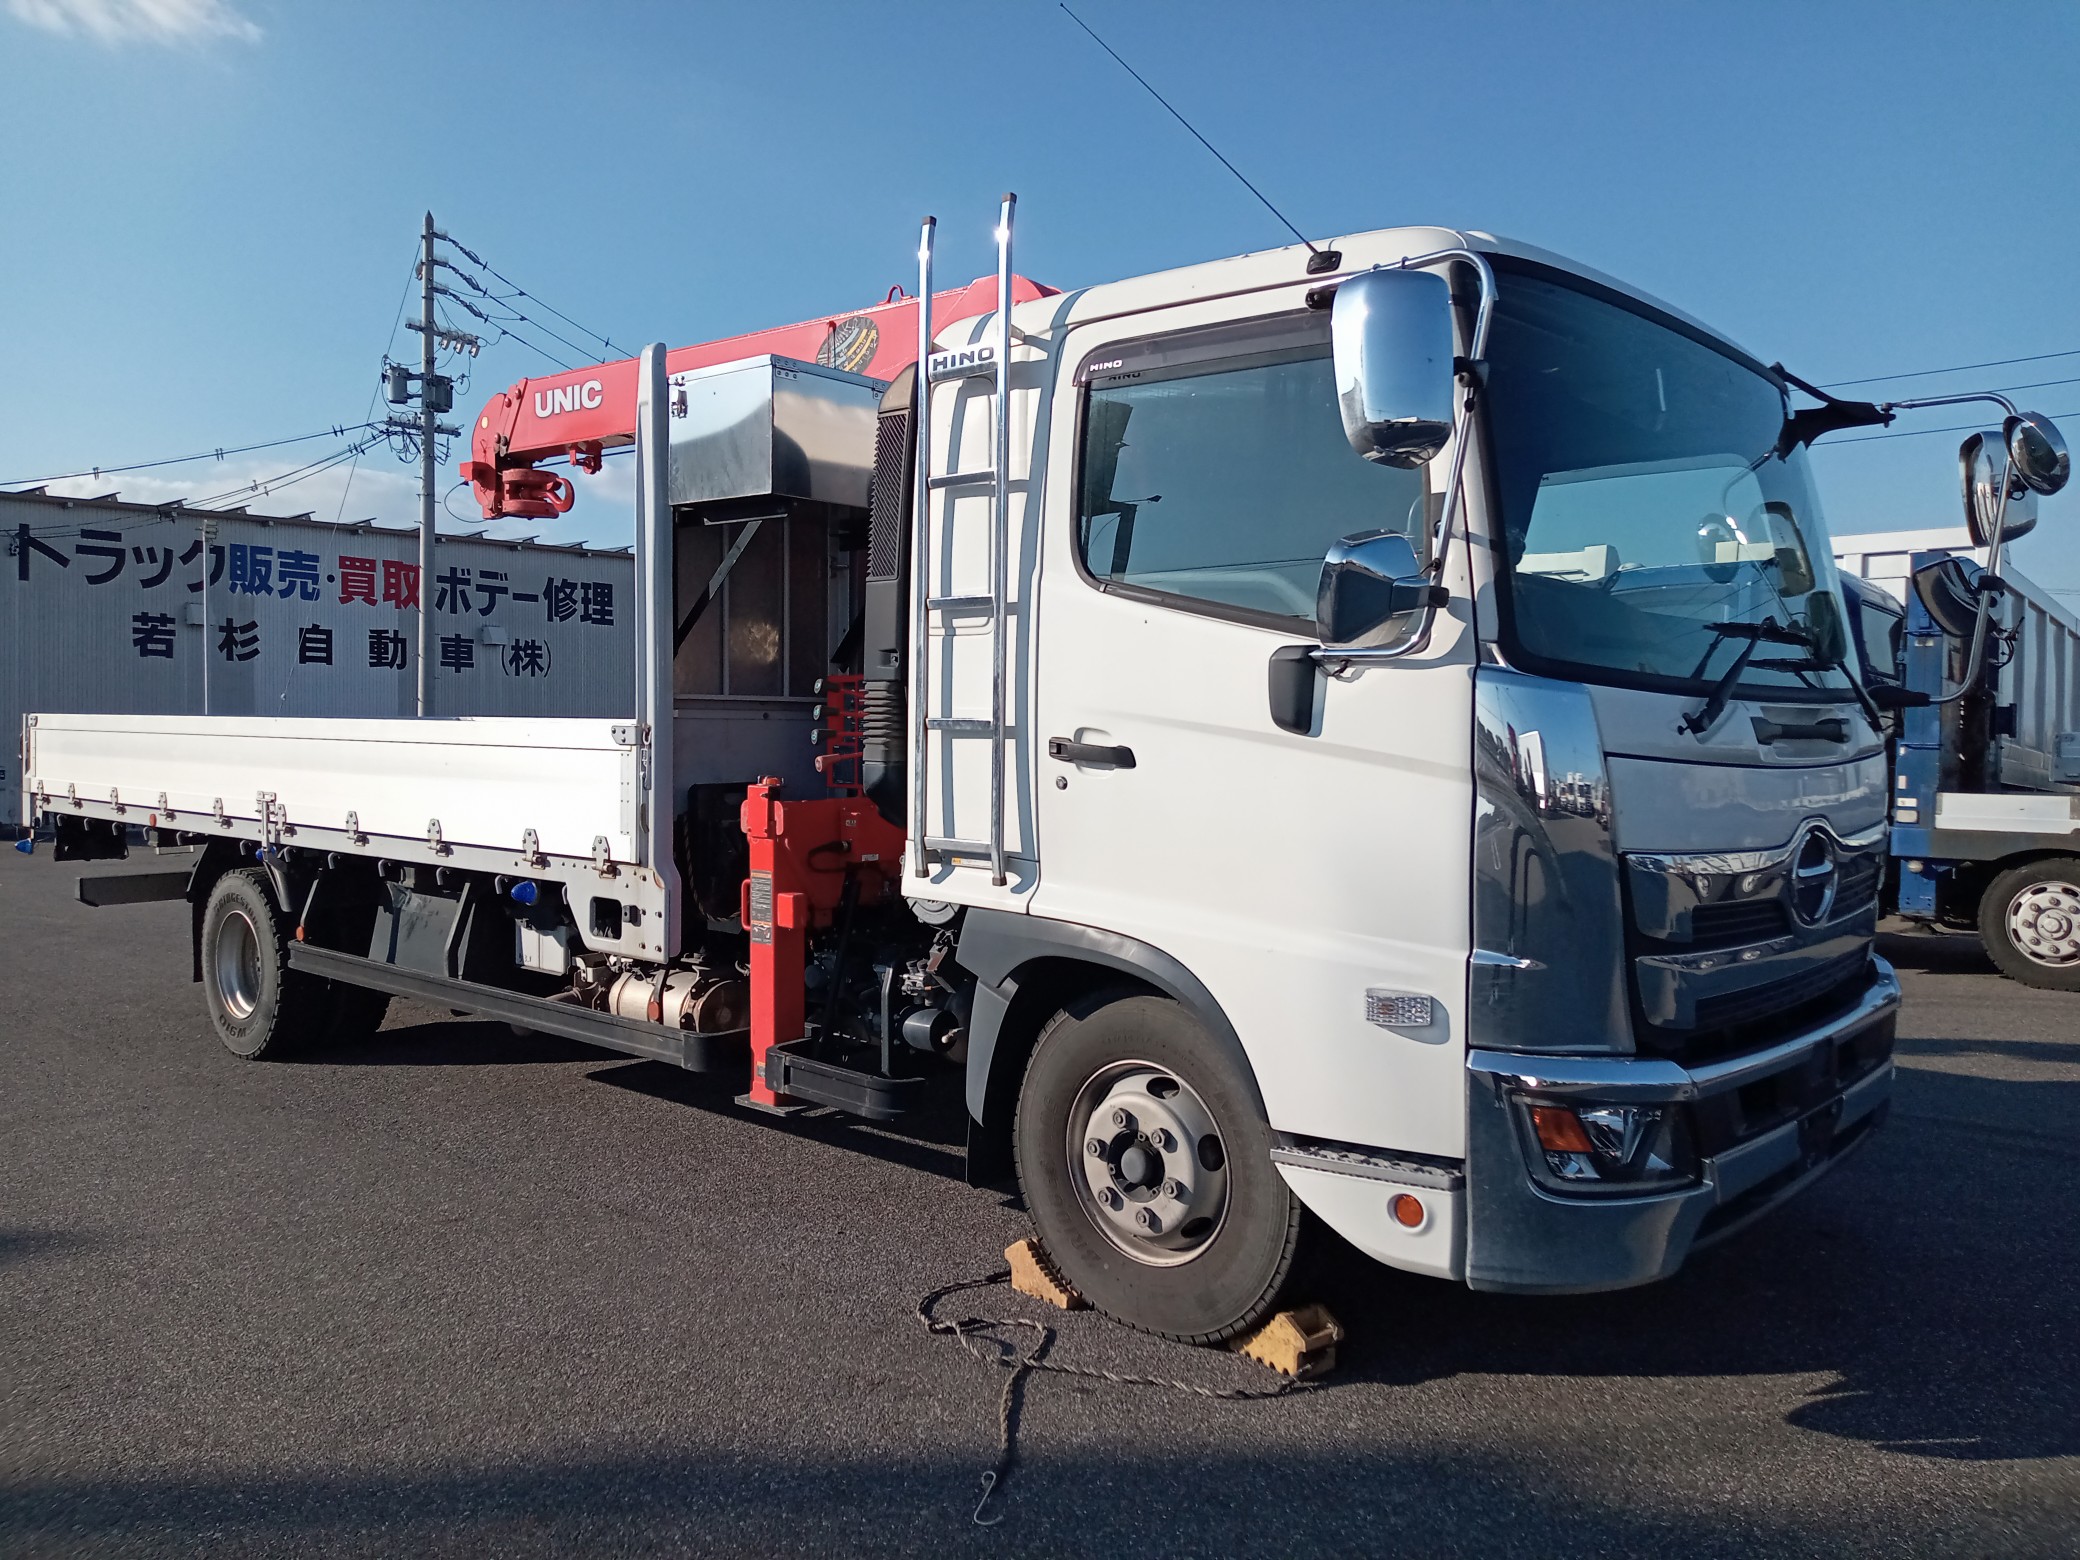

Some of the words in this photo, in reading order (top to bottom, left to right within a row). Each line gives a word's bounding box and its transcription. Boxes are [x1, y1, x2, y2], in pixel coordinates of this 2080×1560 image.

[932, 347, 994, 371] HINO
[1089, 359, 1123, 372] HINO
[534, 379, 603, 419] UNIC
[219, 1013, 247, 1039] W910
